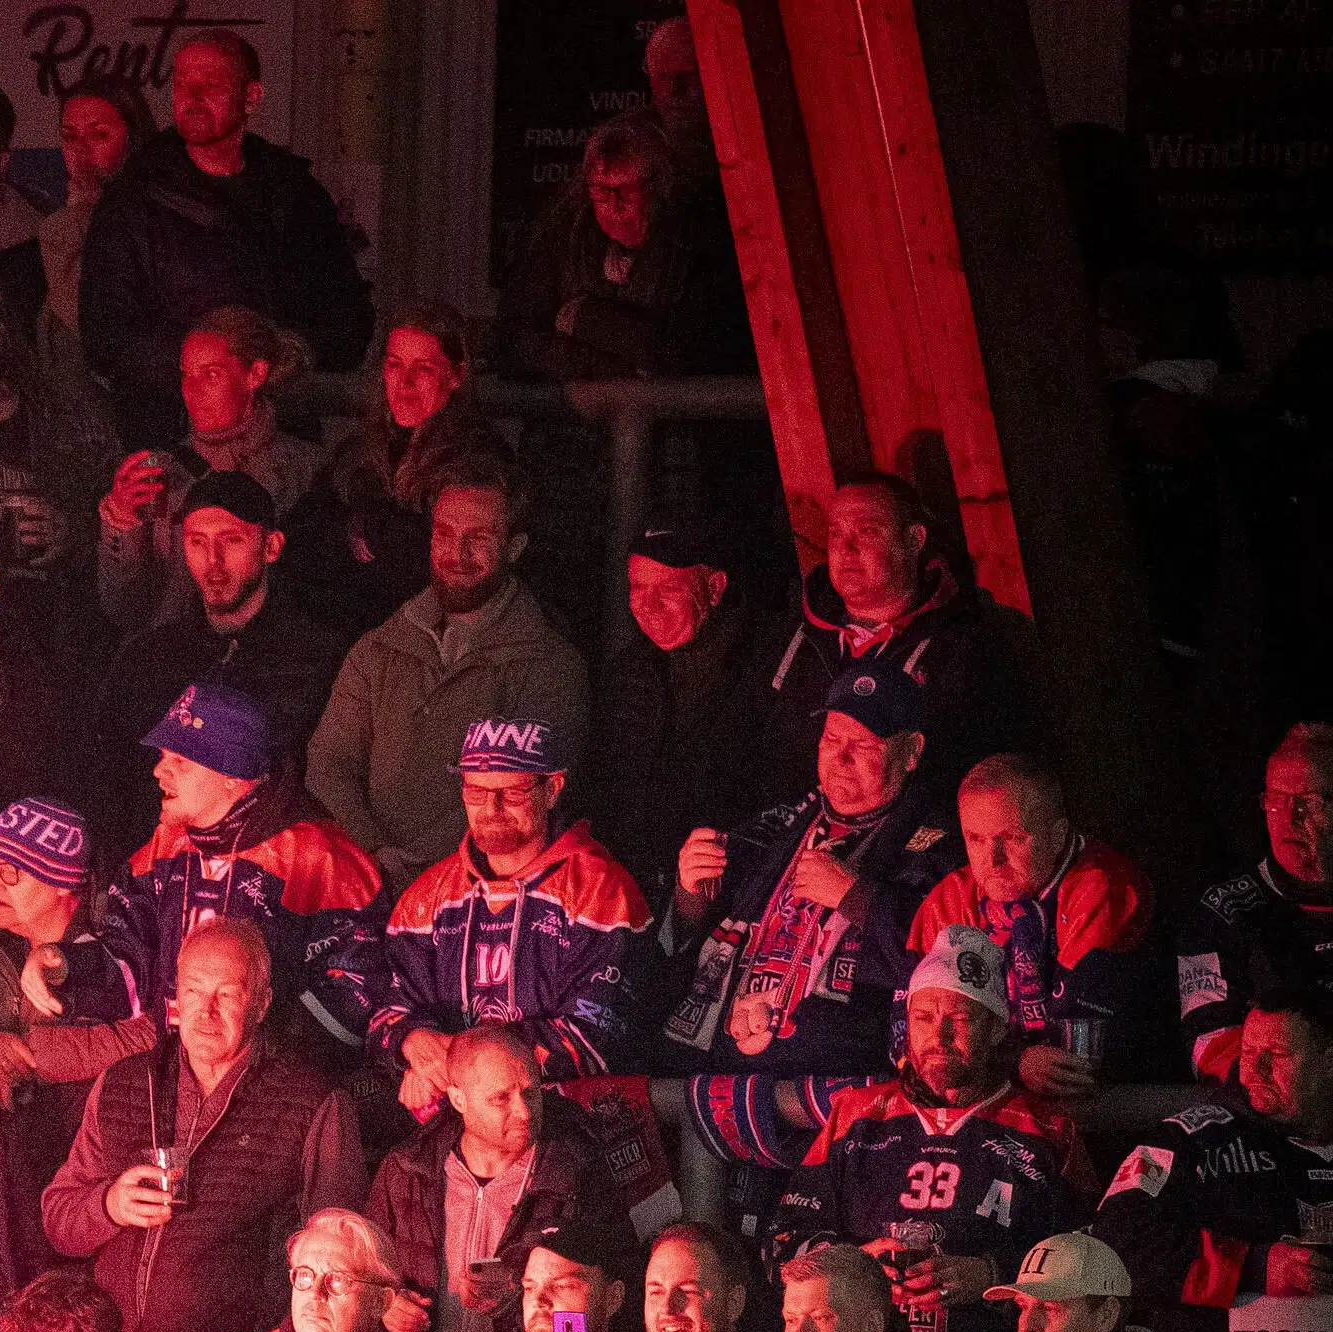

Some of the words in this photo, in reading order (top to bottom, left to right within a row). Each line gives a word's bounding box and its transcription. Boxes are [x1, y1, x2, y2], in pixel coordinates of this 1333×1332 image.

[474, 942, 511, 987] 10
[898, 1160, 962, 1211] 33
[975, 1178, 1014, 1228] A
